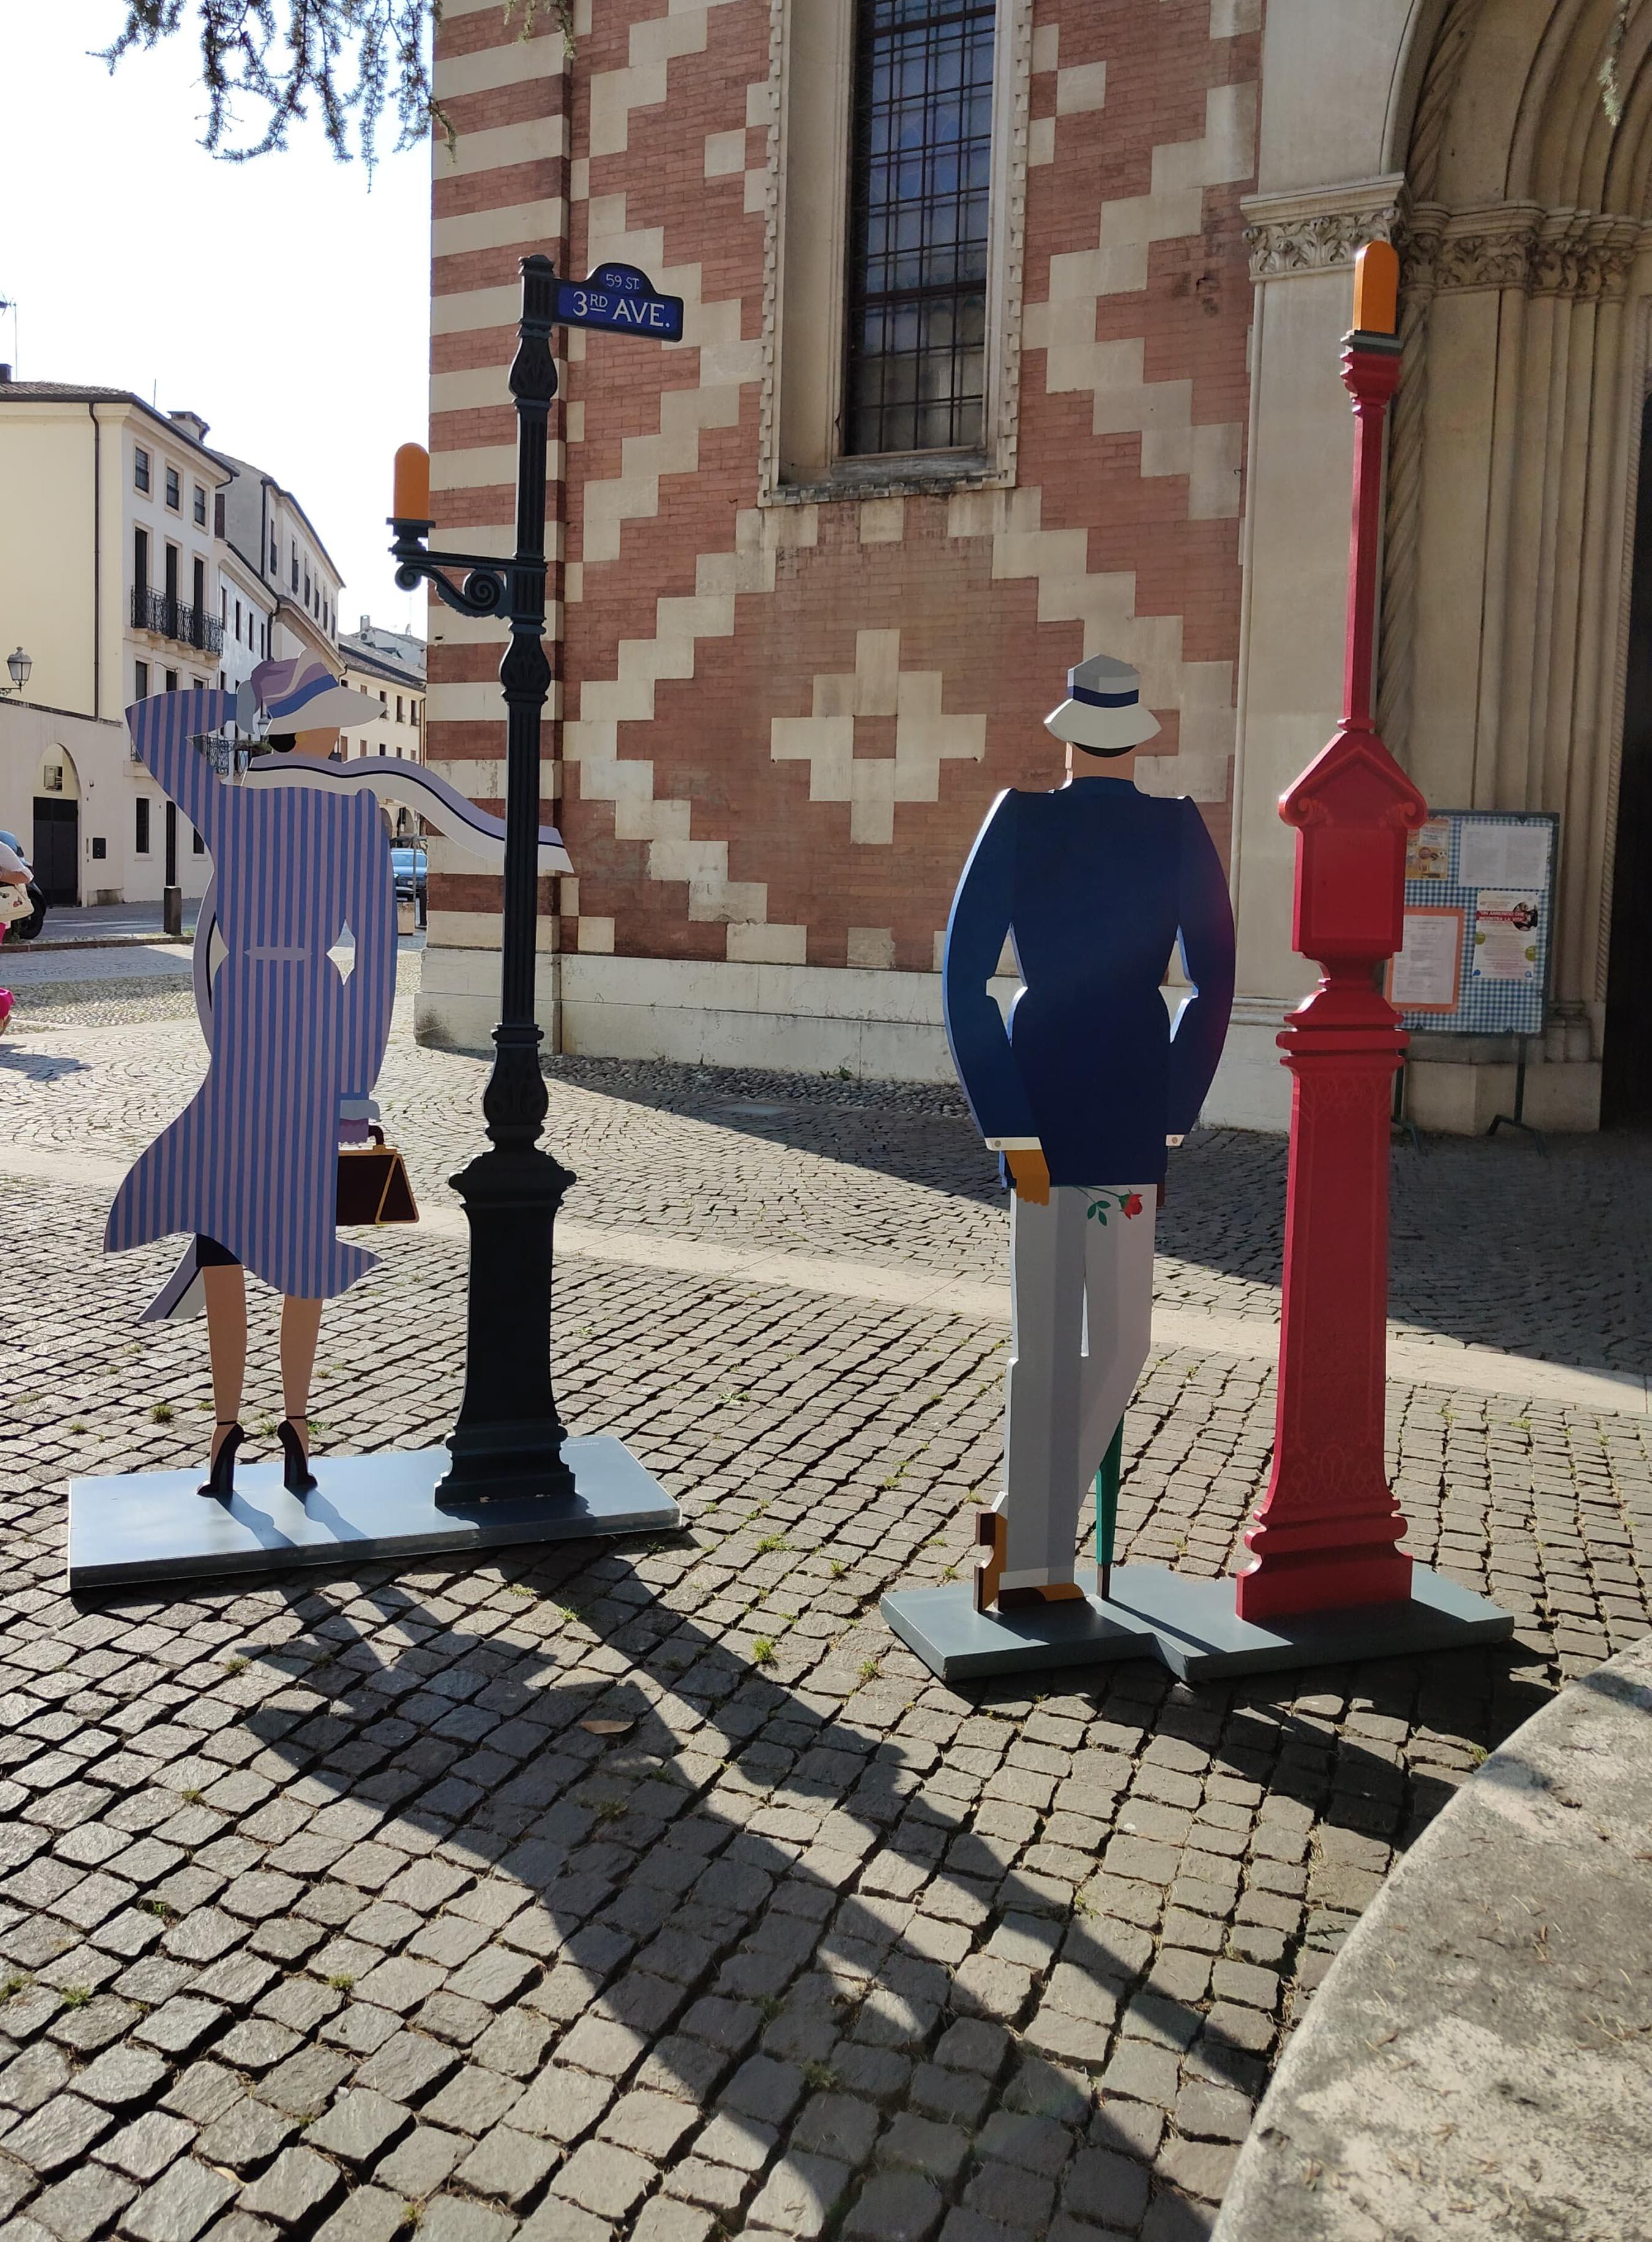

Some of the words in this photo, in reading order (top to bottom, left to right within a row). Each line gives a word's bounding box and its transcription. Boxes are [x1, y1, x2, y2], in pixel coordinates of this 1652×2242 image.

[605, 273, 622, 288] 59
[625, 276, 640, 290] ST.
[572, 291, 608, 317] 3RD
[611, 298, 671, 328] AVE.
